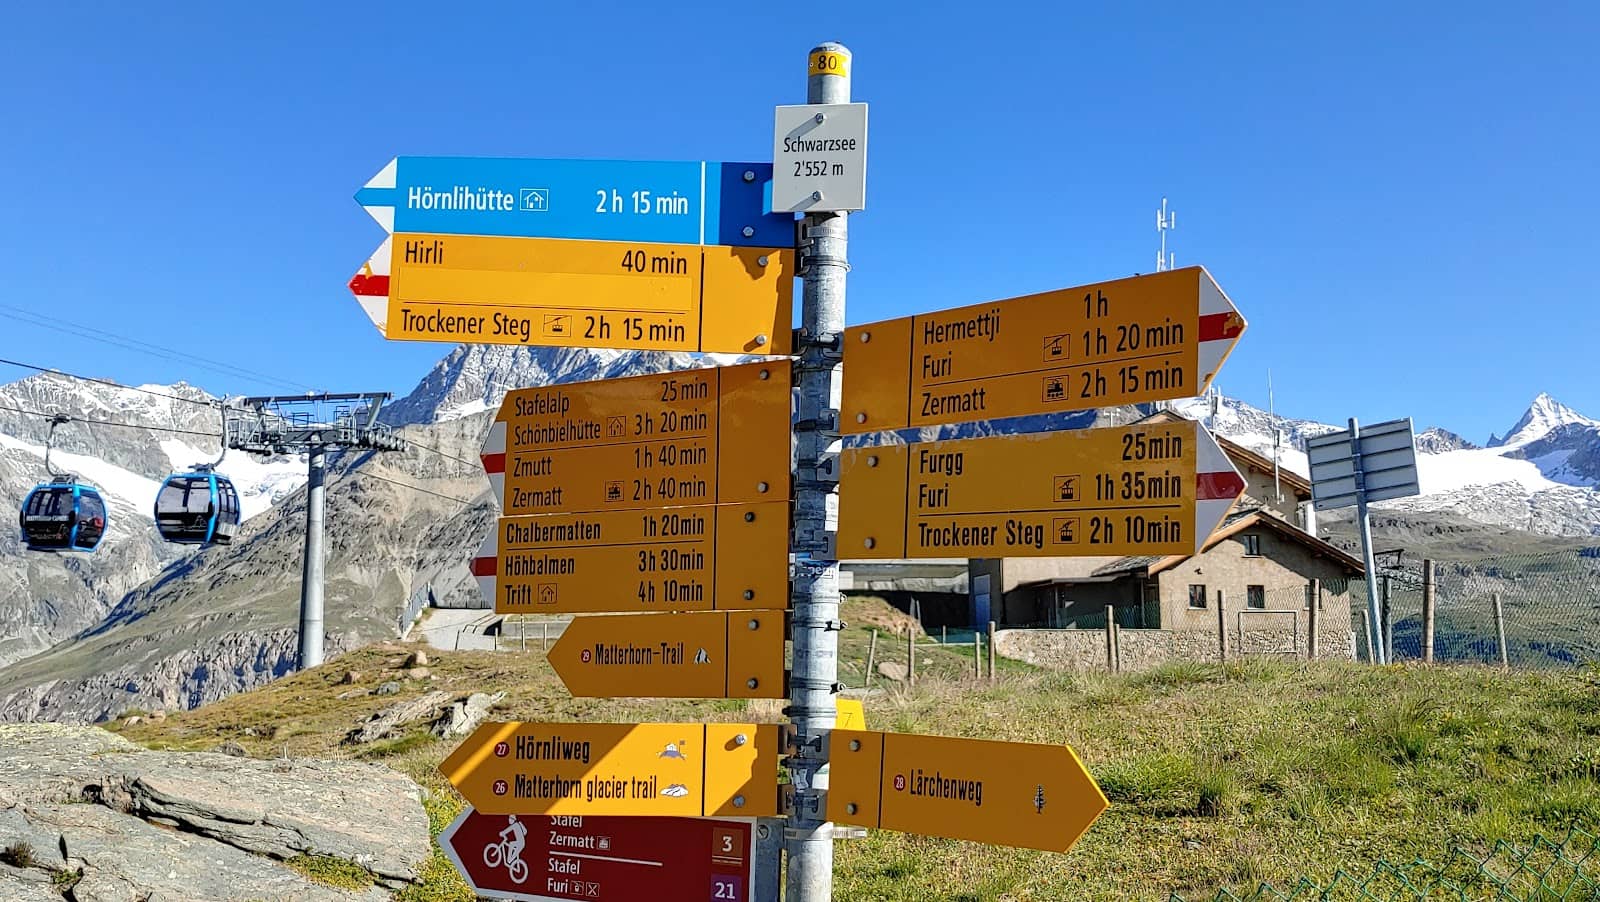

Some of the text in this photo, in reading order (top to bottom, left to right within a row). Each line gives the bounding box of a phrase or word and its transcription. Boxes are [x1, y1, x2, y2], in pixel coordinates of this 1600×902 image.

[817, 54, 838, 70] 80
[783, 136, 856, 153] Schwarzsee
[794, 160, 844, 177] 2'552 m
[407, 186, 514, 212] Hörnlihütte
[405, 241, 687, 275] Hirli 40 min
[401, 309, 484, 335] Trockener
[492, 312, 531, 340] Steg
[924, 308, 1000, 345] Hermettji
[922, 351, 952, 379] Furi
[515, 391, 570, 417] Stafelalp
[922, 387, 986, 417] Zermatt
[514, 420, 601, 446] Schönbielhütte
[513, 457, 552, 477] Zmutt
[919, 450, 963, 477] Furgg
[512, 486, 562, 508] Zermatt
[919, 483, 949, 508] Furi
[506, 521, 601, 545] Chalbermatten
[918, 522, 998, 548] Trockener
[1006, 519, 1044, 549] Steg
[505, 554, 575, 577] Höhbalmen
[505, 583, 532, 605] Trift
[497, 735, 590, 764] 27 Hörnliweg
[495, 774, 657, 802] 26 Matterhorn glacier trail
[894, 769, 982, 807] 28 Lärchenweg
[550, 815, 583, 828] Stafel
[549, 831, 595, 849] Zermatt
[721, 835, 733, 852] 3
[547, 858, 581, 875] Stafel
[547, 877, 569, 894] Furi
[714, 881, 736, 900] 21
